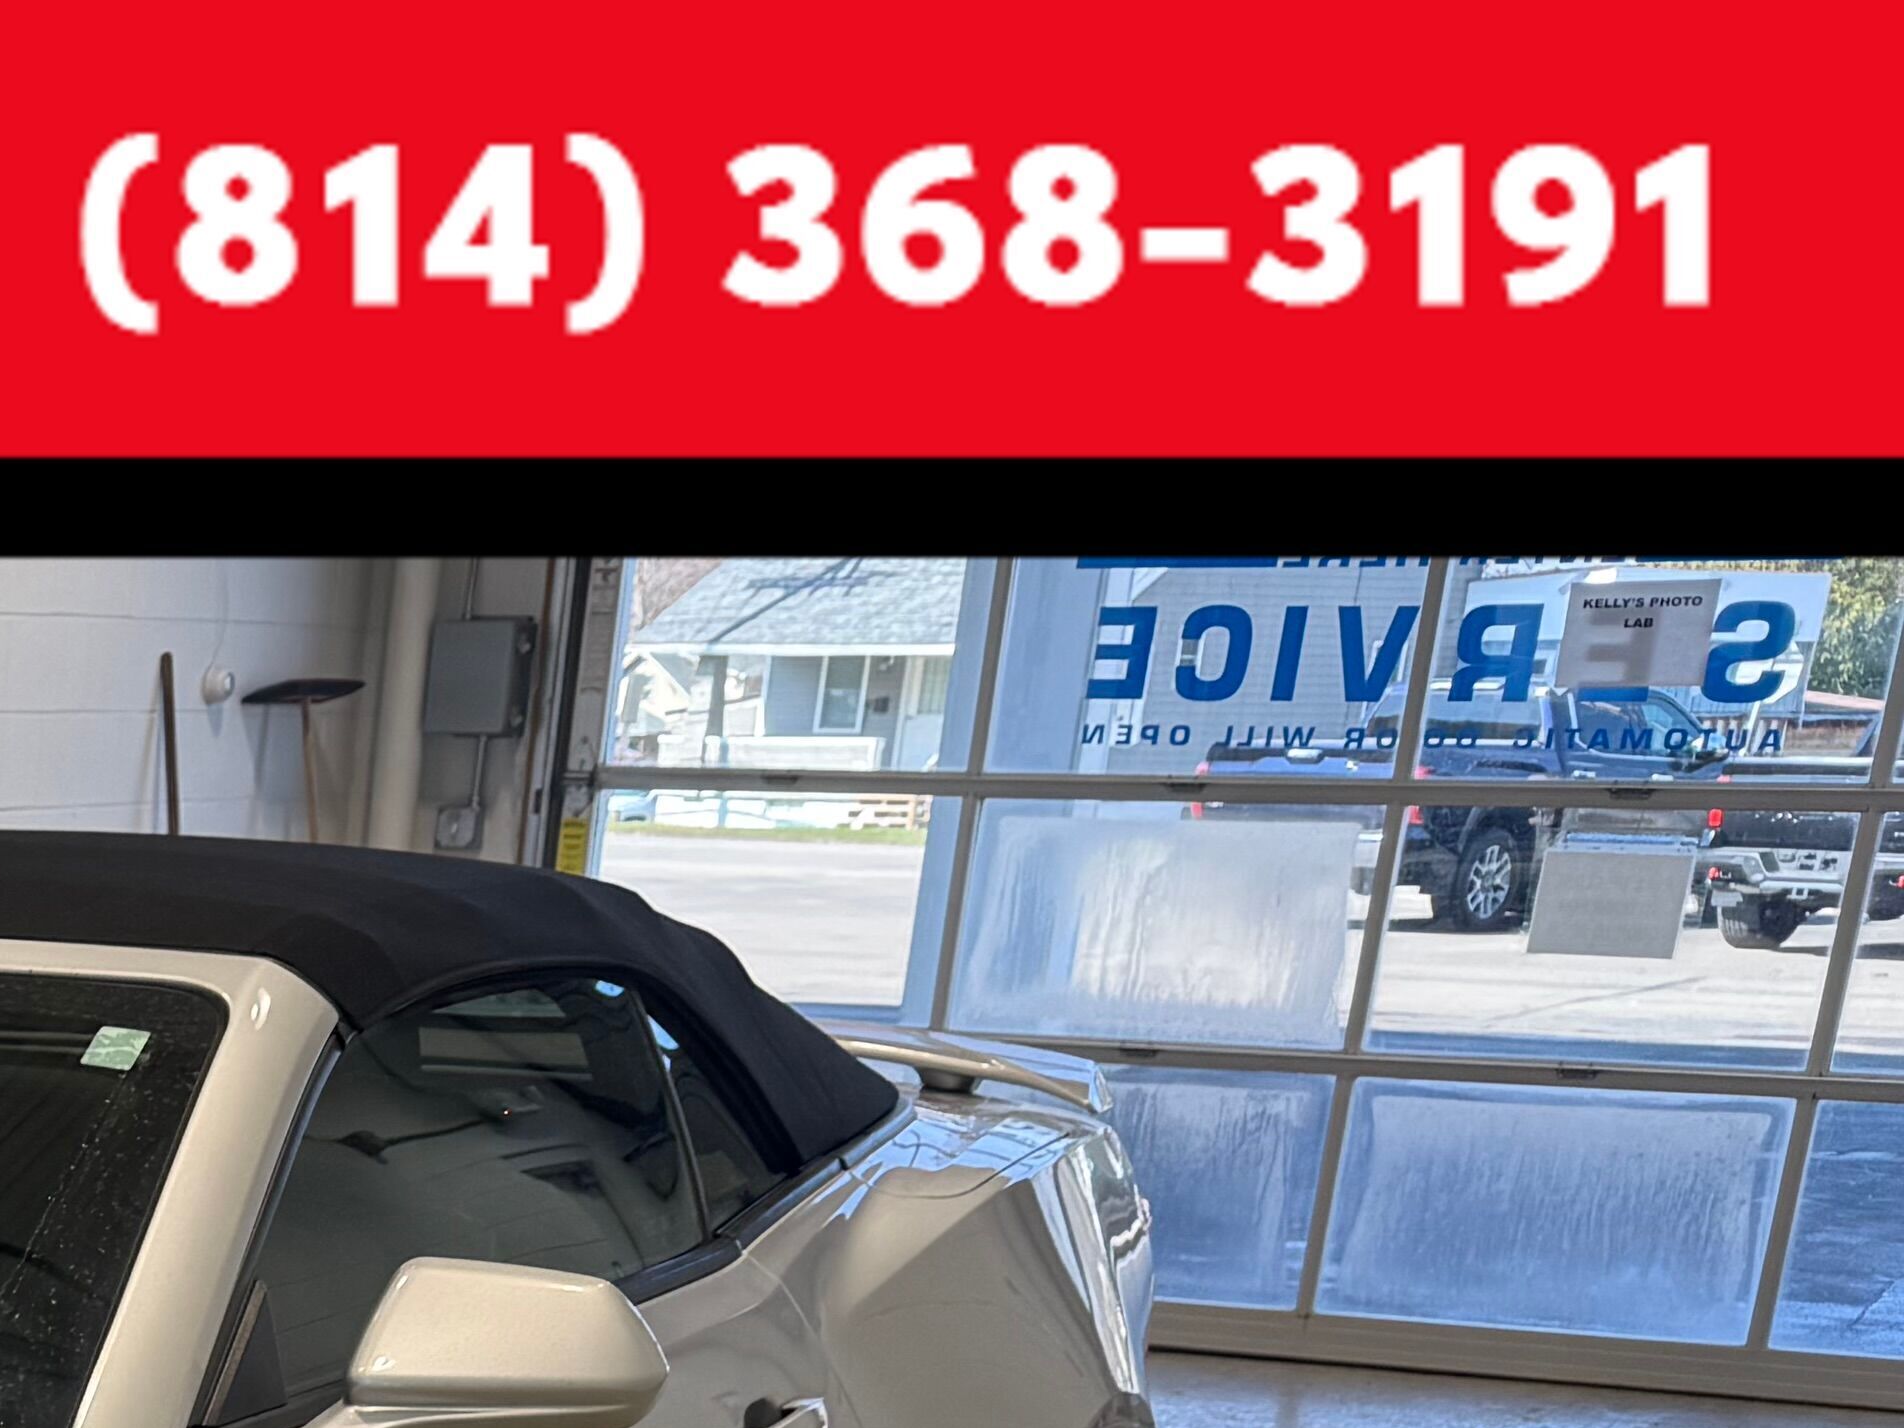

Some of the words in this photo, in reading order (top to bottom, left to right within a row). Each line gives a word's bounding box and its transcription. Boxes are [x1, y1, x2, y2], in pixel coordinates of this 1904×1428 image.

[1582, 597, 1645, 609] KELLY'S
[1649, 595, 1704, 608] PHOTO
[1623, 617, 1654, 629] LAB
